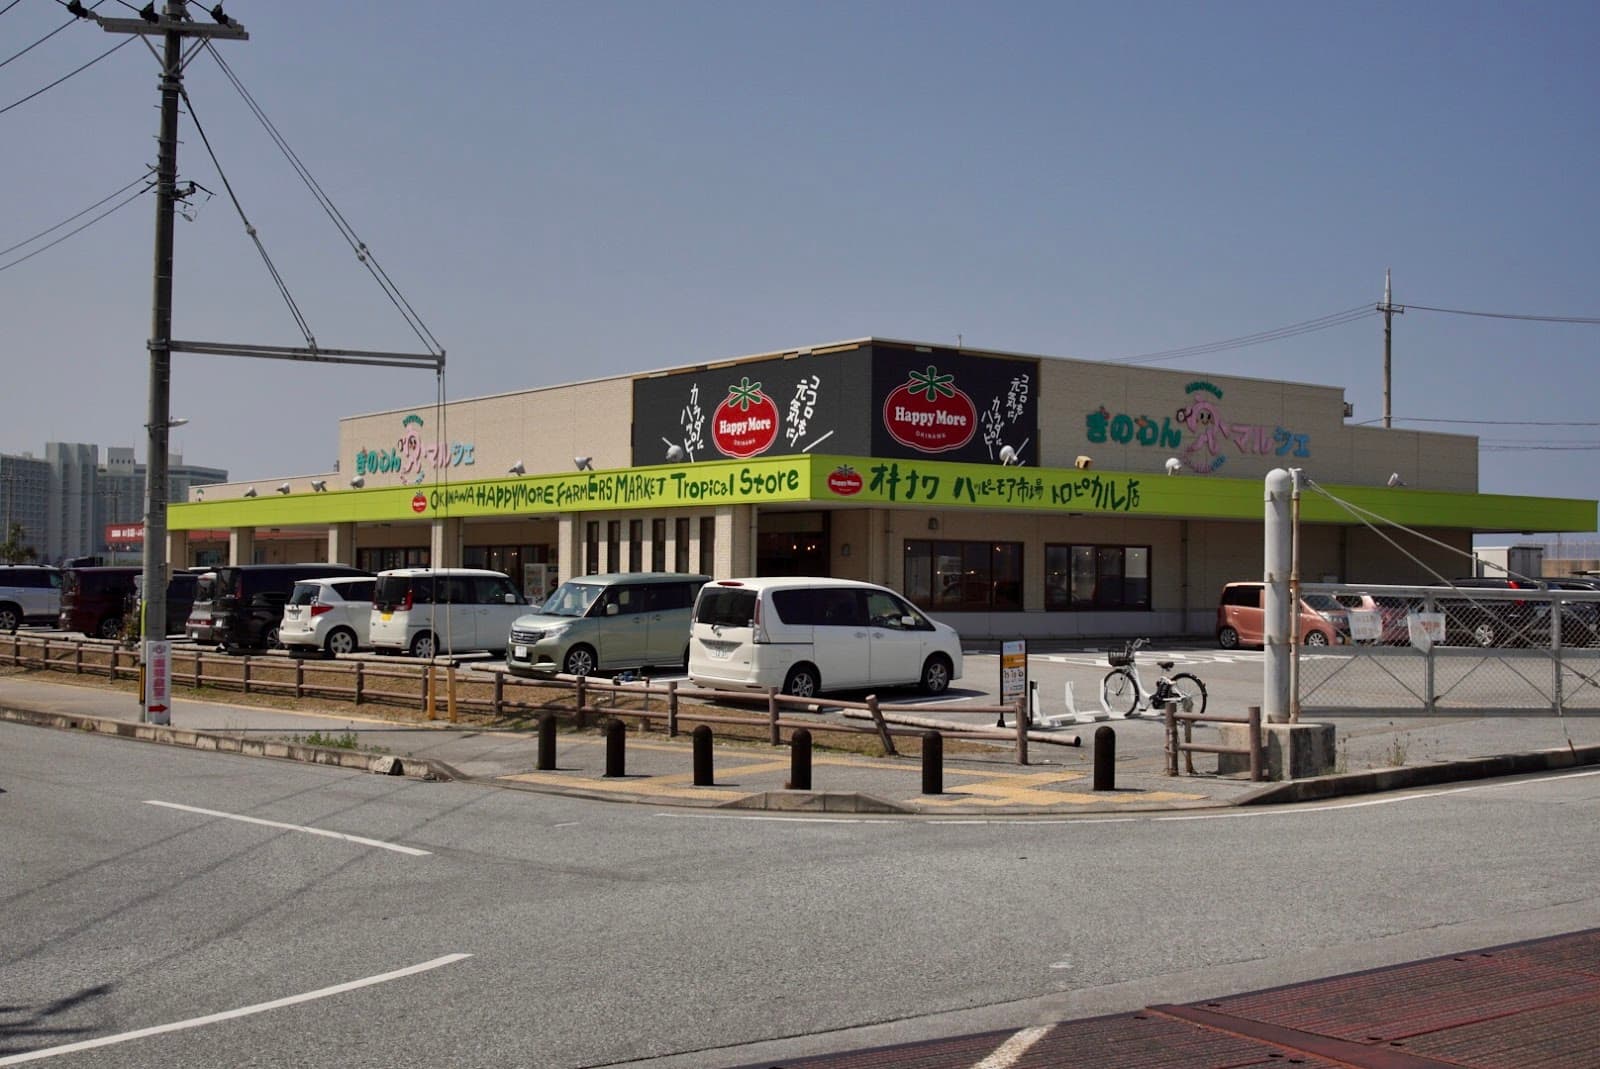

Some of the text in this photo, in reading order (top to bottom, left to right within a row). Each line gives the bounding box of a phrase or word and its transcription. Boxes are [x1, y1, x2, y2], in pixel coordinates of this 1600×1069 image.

[719, 416, 771, 436] Happy More
[895, 406, 967, 427] Happy More
[430, 485, 474, 510] OKINAWA
[557, 474, 612, 506] FARMERS
[614, 473, 666, 504] MARKET
[670, 472, 734, 500] Tropical
[739, 468, 799, 496] Store
[870, 463, 1140, 511] オキナワ ハッピーモア市場 トロピカル店
